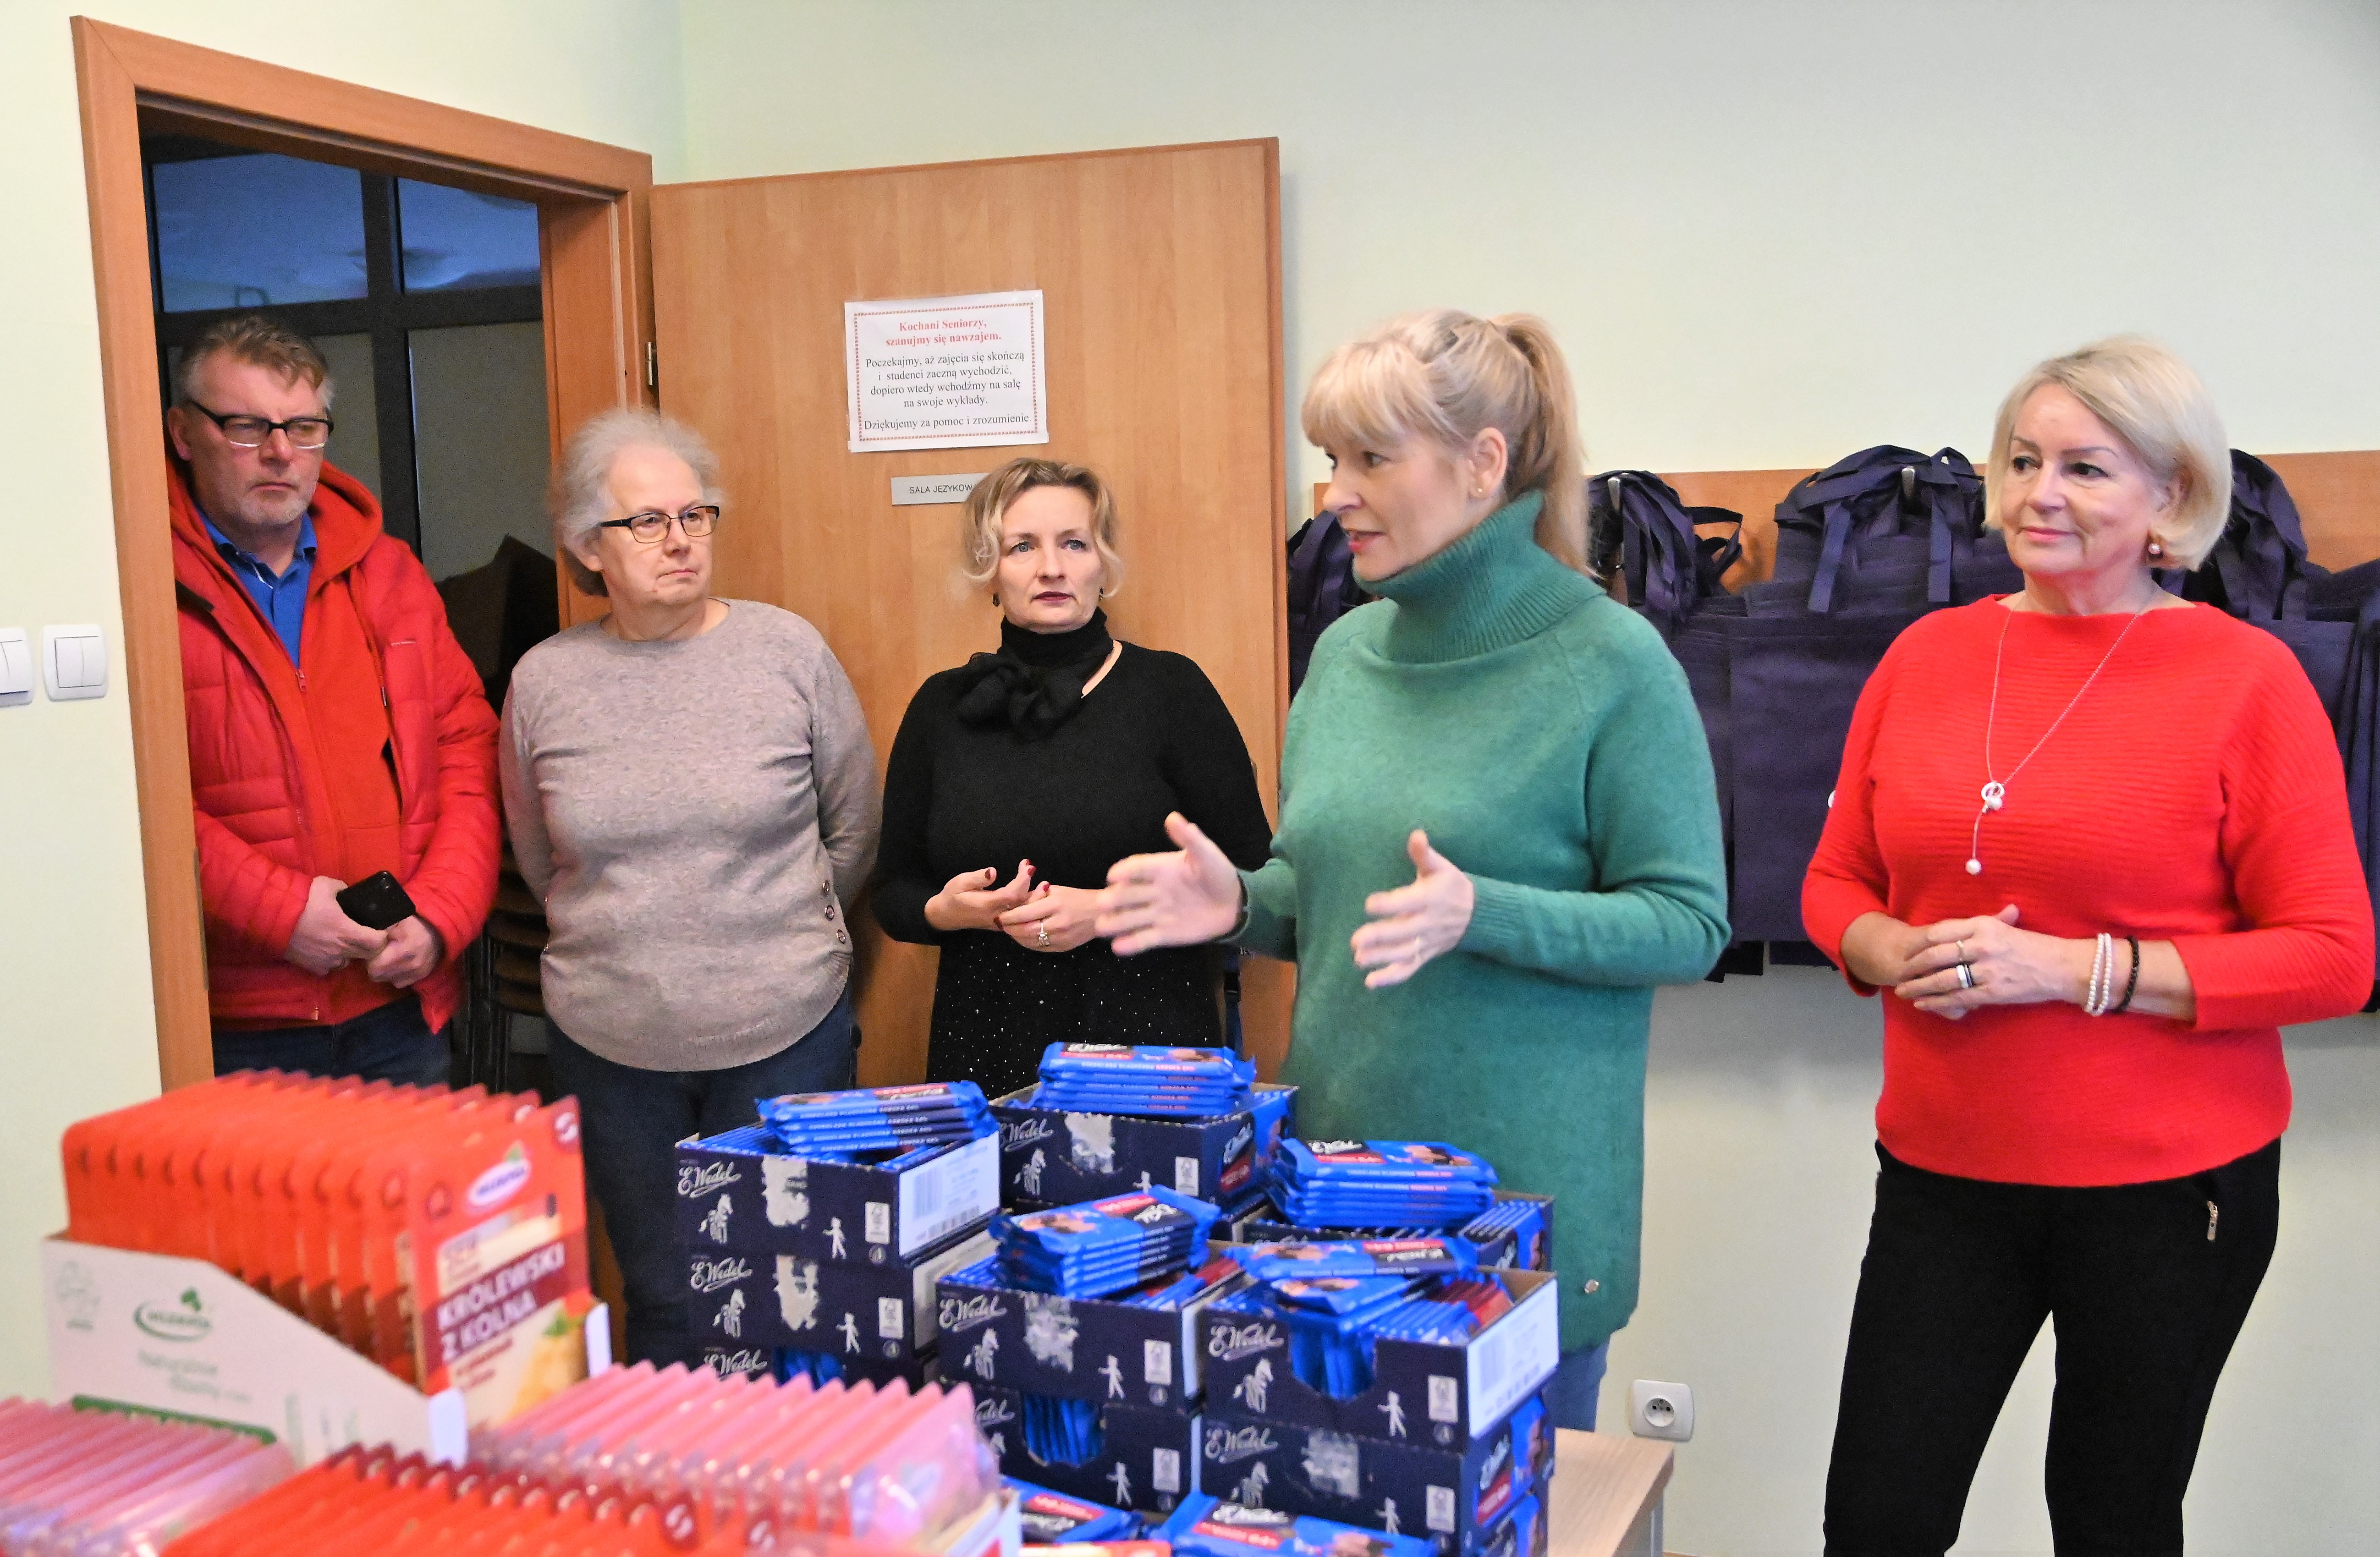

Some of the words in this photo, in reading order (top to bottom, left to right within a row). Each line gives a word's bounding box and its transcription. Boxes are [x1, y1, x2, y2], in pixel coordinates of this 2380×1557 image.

[900, 321, 939, 331] Kochani
[942, 319, 987, 329] Seniorzy,
[886, 336, 931, 347] szanujmy
[934, 334, 946, 345] się
[950, 332, 1001, 343] nawzajem.
[866, 356, 922, 368] Poczekajmy,
[925, 356, 935, 364] aż
[938, 353, 969, 366] zajęcia
[972, 352, 984, 364] się
[987, 351, 1024, 362] skończą
[878, 372, 881, 381] i
[887, 369, 923, 380] studenci
[926, 369, 956, 379] zaczną
[960, 365, 1012, 378] wychodzić,
[871, 385, 904, 397] dopiero
[907, 383, 934, 395] wtedy
[937, 381, 986, 392] wchodźmy
[1003, 378, 1021, 390] salę
[917, 397, 943, 408] swoje
[946, 395, 988, 407] wykłady.
[864, 419, 917, 431] Dziękujemy
[933, 418, 963, 428] pomoc
[967, 416, 969, 425] i
